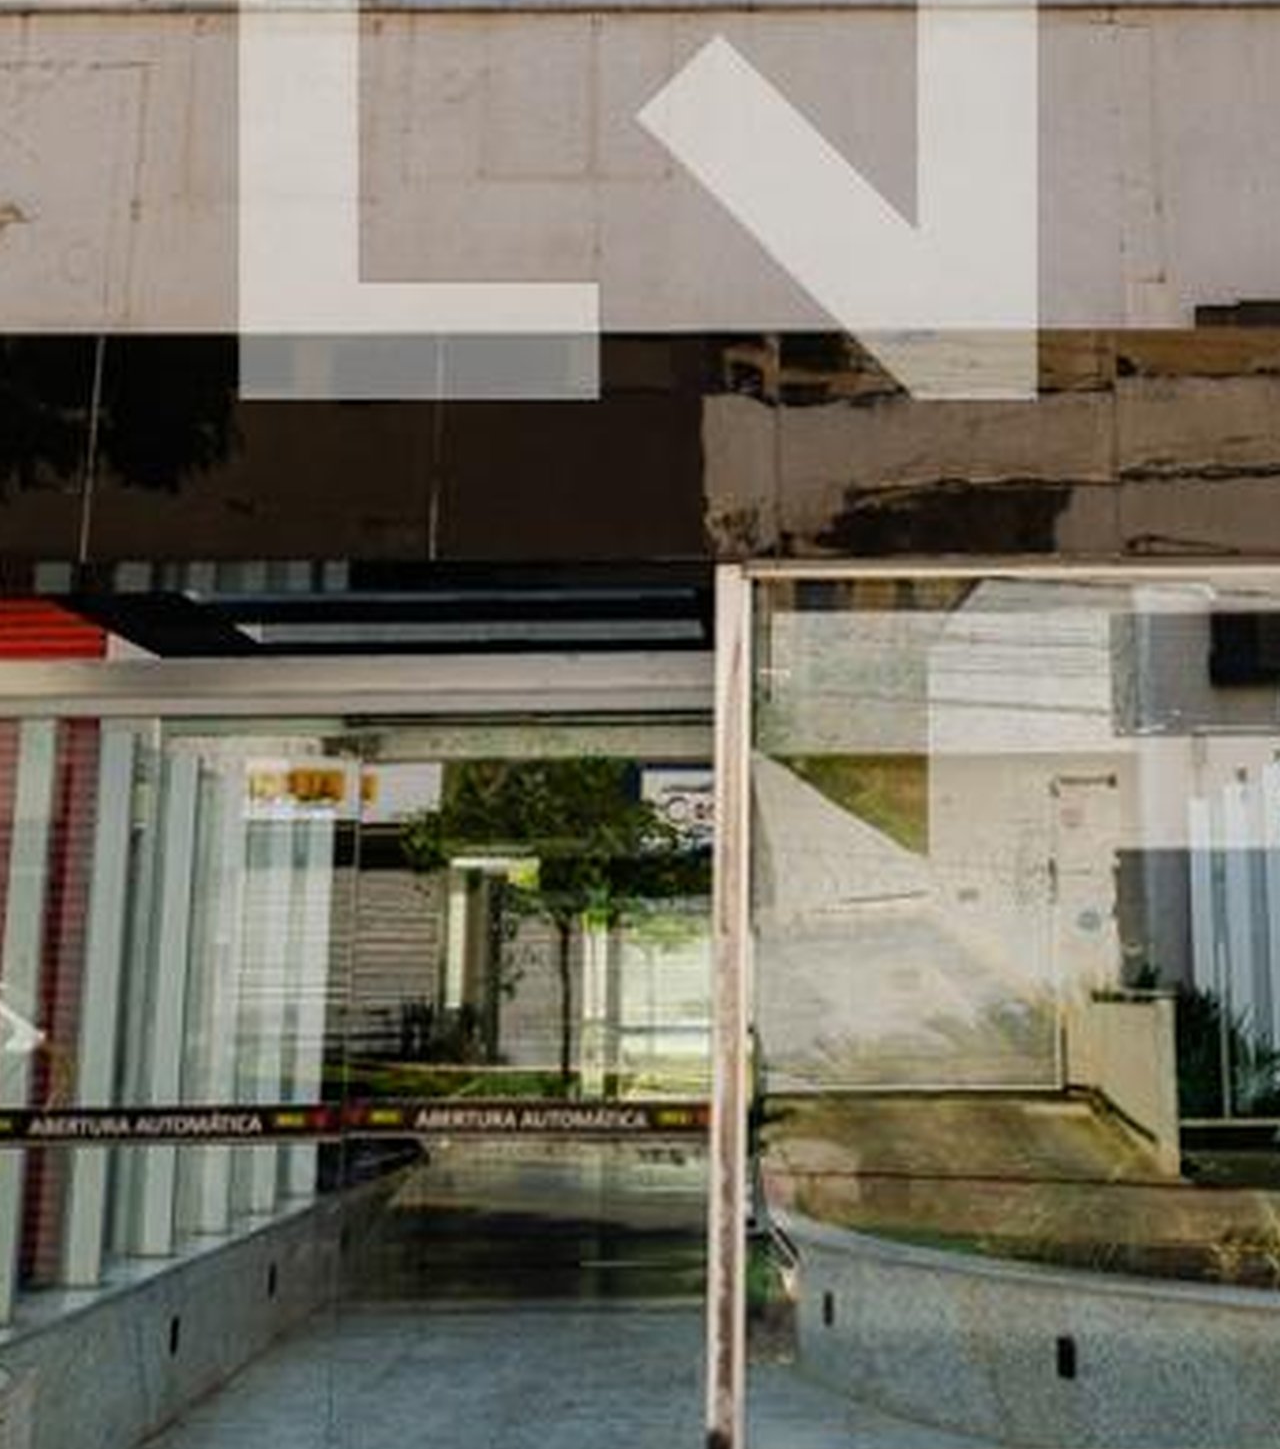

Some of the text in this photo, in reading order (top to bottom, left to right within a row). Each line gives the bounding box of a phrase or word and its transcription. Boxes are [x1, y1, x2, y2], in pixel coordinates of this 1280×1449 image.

[28, 1115, 128, 1135] ABERTURA
[135, 1110, 263, 1134] AUTOMÁTICA
[415, 1108, 517, 1128] ABERTURA
[520, 1106, 648, 1128] AUTOMÁTICA
